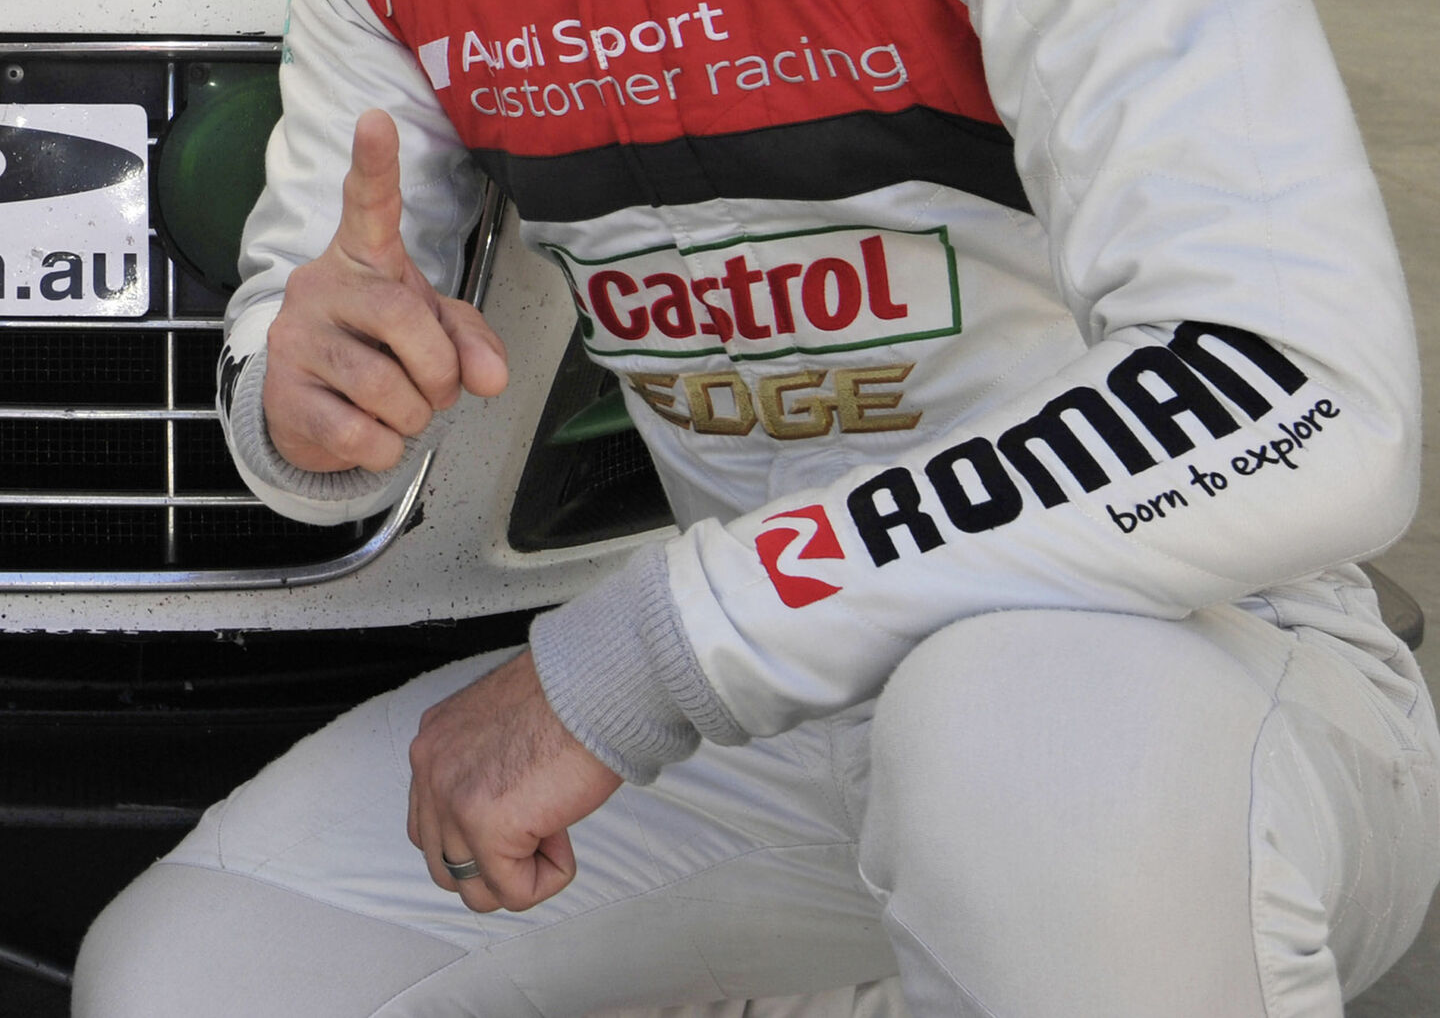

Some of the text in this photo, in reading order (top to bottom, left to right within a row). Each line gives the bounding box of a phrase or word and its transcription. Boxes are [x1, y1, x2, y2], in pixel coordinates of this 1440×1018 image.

[462, 2, 729, 73] Audi Sport
[706, 36, 909, 94] racing
[587, 234, 908, 344] Castrol
[627, 362, 923, 441] EDGE
[846, 321, 1309, 567] ROMAN
[1105, 398, 1341, 533] born to explore
